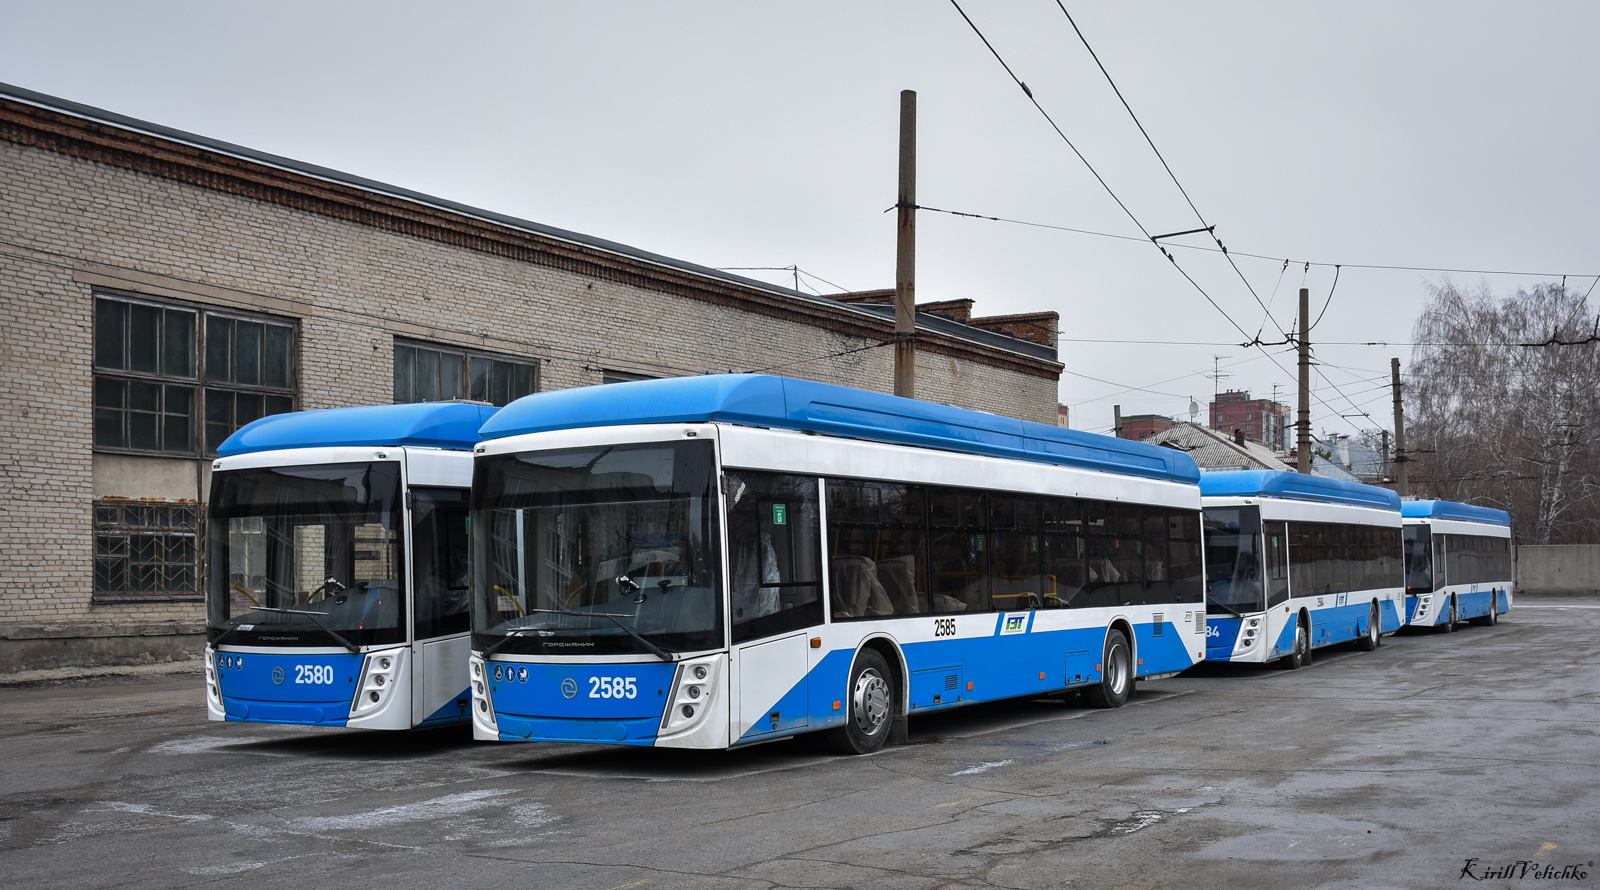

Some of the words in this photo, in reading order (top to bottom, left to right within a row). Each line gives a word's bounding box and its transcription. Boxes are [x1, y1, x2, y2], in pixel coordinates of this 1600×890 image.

[934, 618, 956, 637] 2585
[295, 664, 334, 685] 2580
[588, 676, 638, 699] 2585
